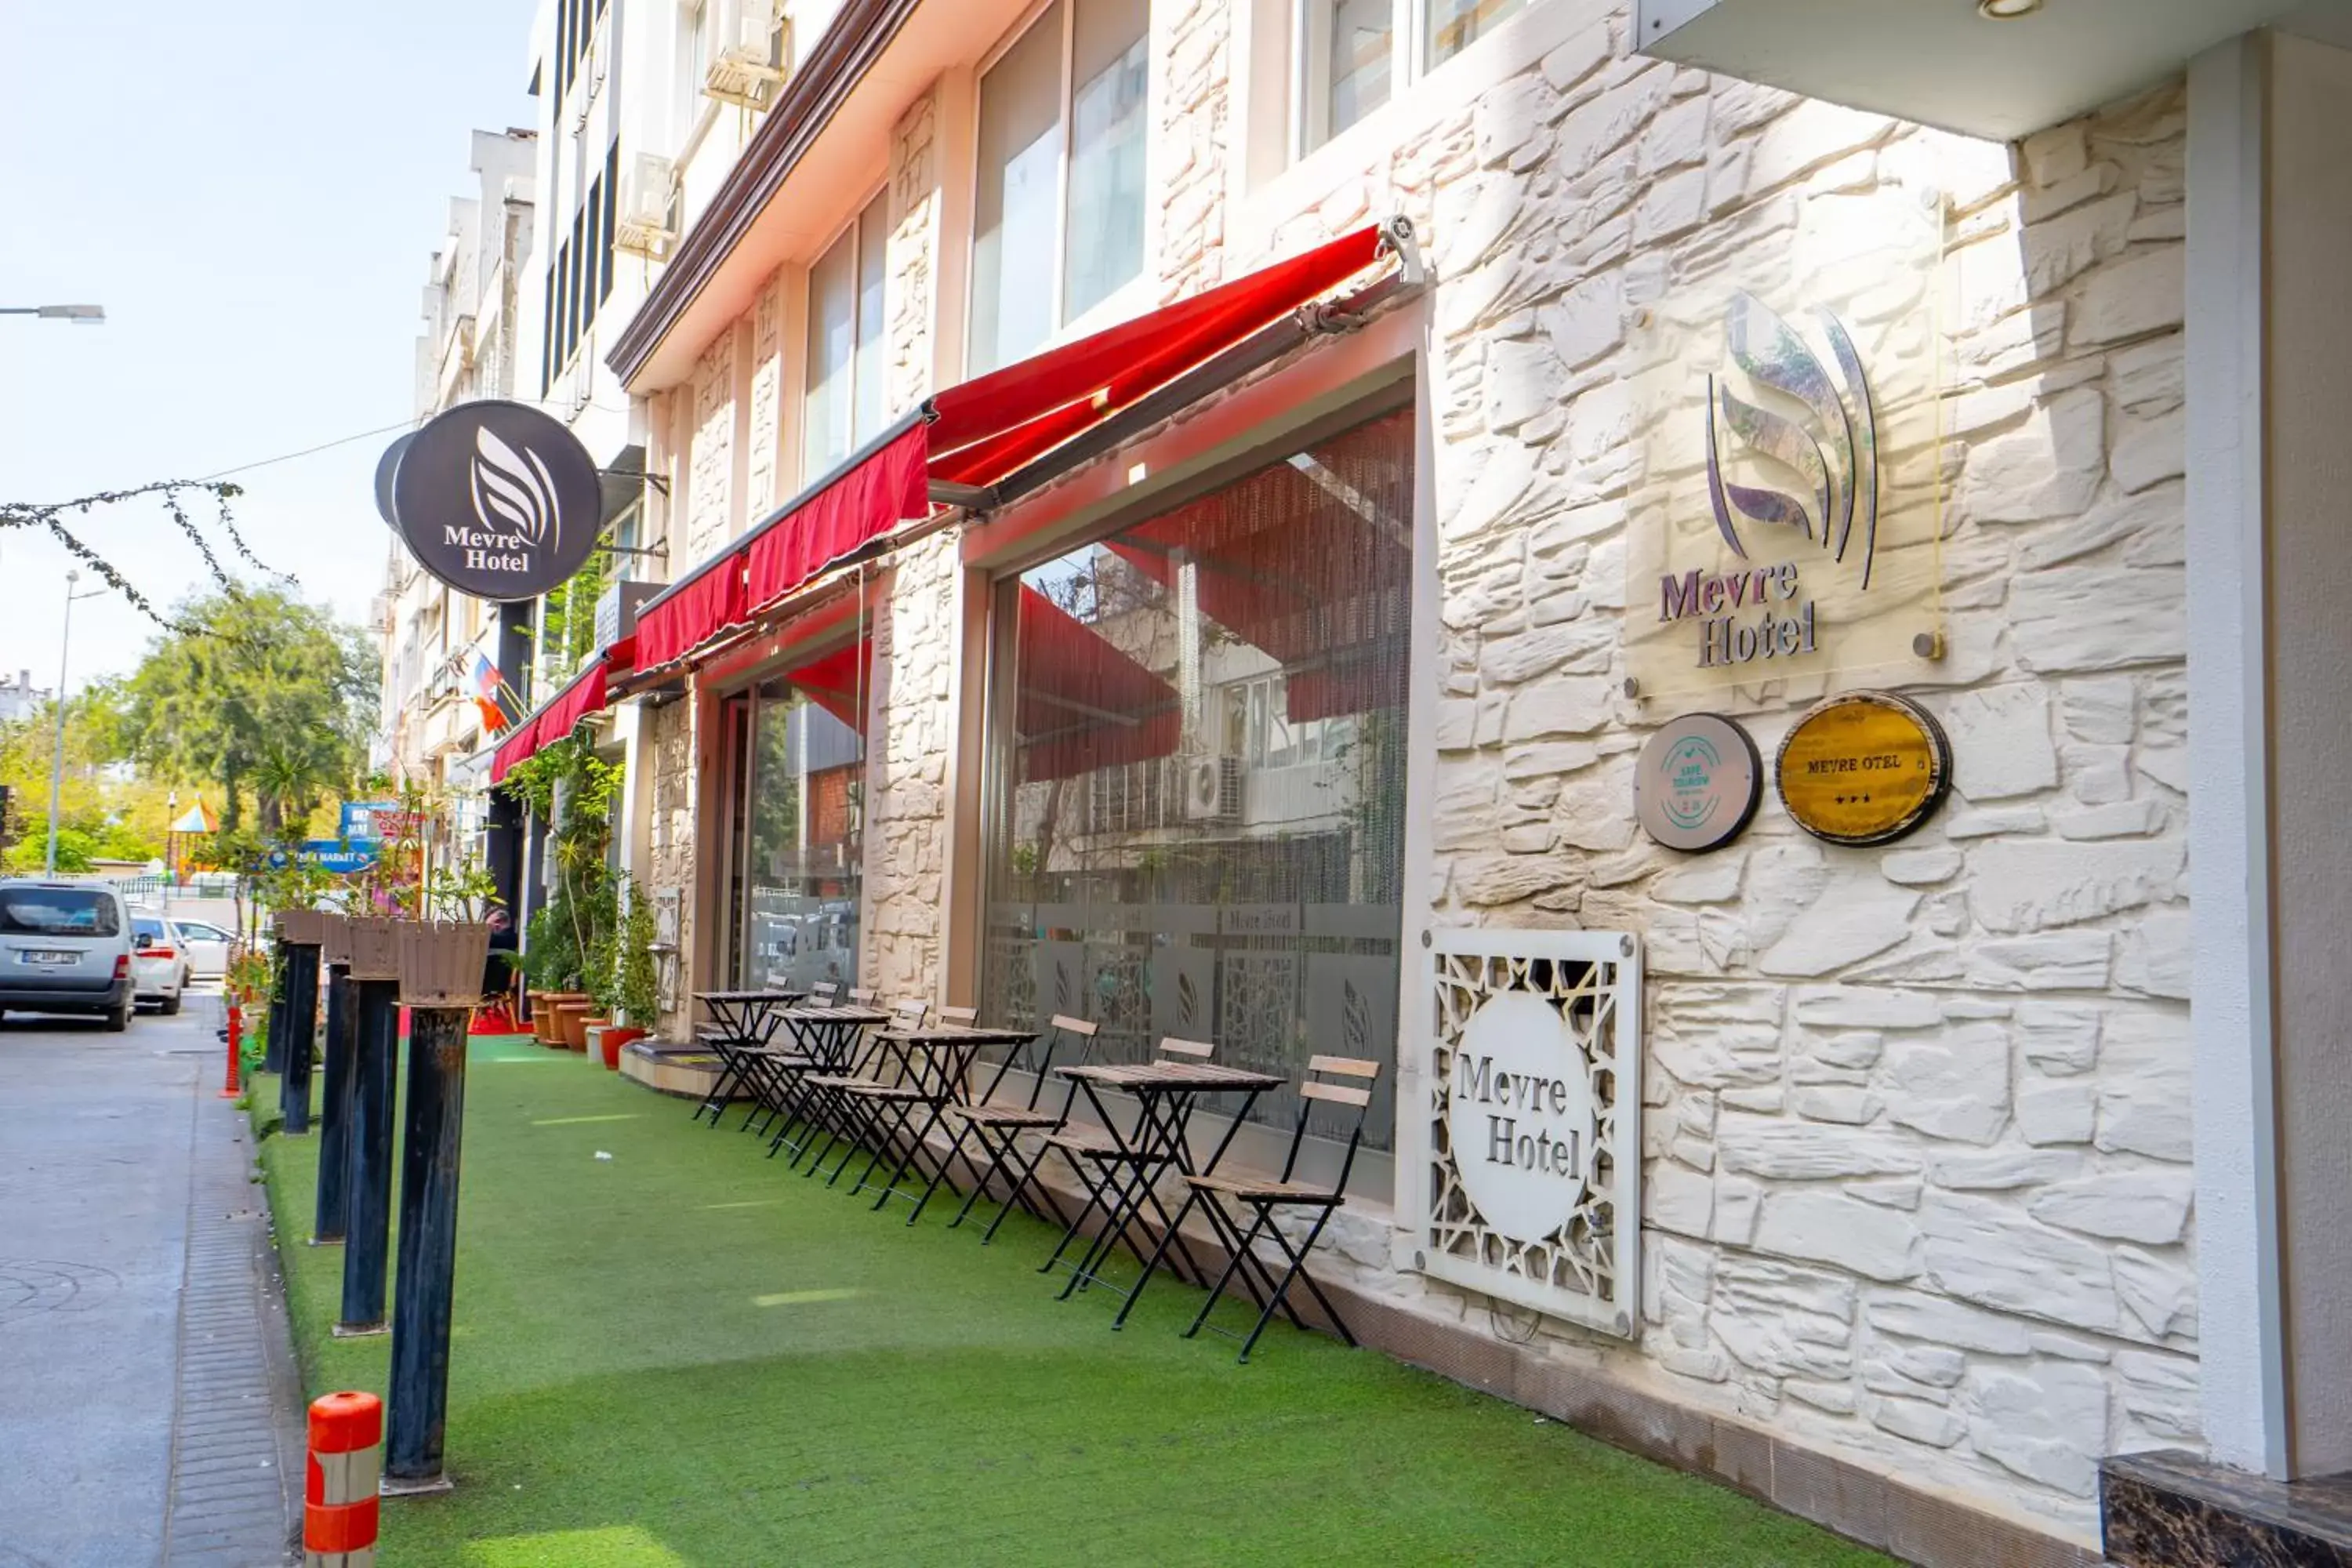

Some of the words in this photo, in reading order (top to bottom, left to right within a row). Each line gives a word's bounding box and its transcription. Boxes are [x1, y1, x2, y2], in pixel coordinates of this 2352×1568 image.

[444, 524, 521, 549] Mevre
[465, 548, 529, 572] Hotel
[1658, 561, 1798, 622] Mevre
[1695, 600, 1818, 668] Hotel
[1808, 758, 1857, 774] MEVRE
[1862, 755, 1901, 770] OTEL
[1457, 1053, 1566, 1116] Mevre
[1486, 1115, 1580, 1180] Hotel
